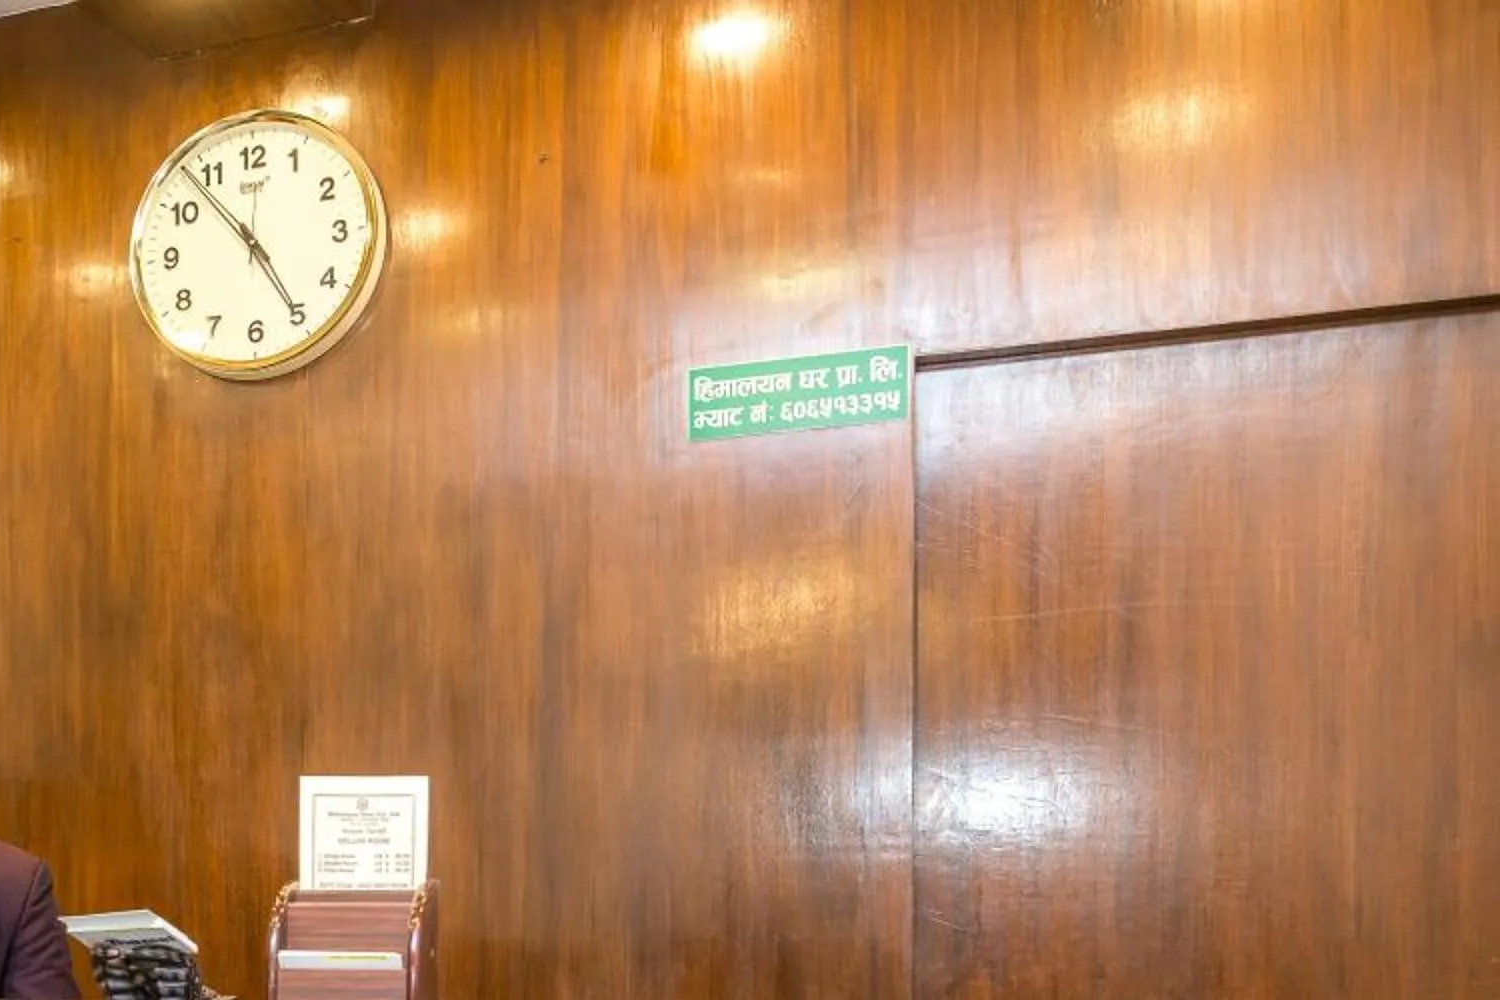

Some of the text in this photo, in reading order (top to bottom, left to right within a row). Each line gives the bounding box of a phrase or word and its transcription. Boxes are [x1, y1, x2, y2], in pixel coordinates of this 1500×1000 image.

[239, 145, 267, 170] 12
[287, 148, 300, 173] 1
[200, 162, 224, 186] 11
[319, 177, 337, 201] 2
[171, 201, 199, 226] 10
[331, 219, 349, 243] 3
[163, 246, 180, 270] 9
[319, 266, 337, 289] 4
[175, 289, 192, 311] 8
[206, 314, 223, 338] 7
[289, 303, 307, 326] 5
[247, 320, 265, 343] 6
[694, 373, 793, 402] हिमालयन
[799, 367, 831, 389] घर
